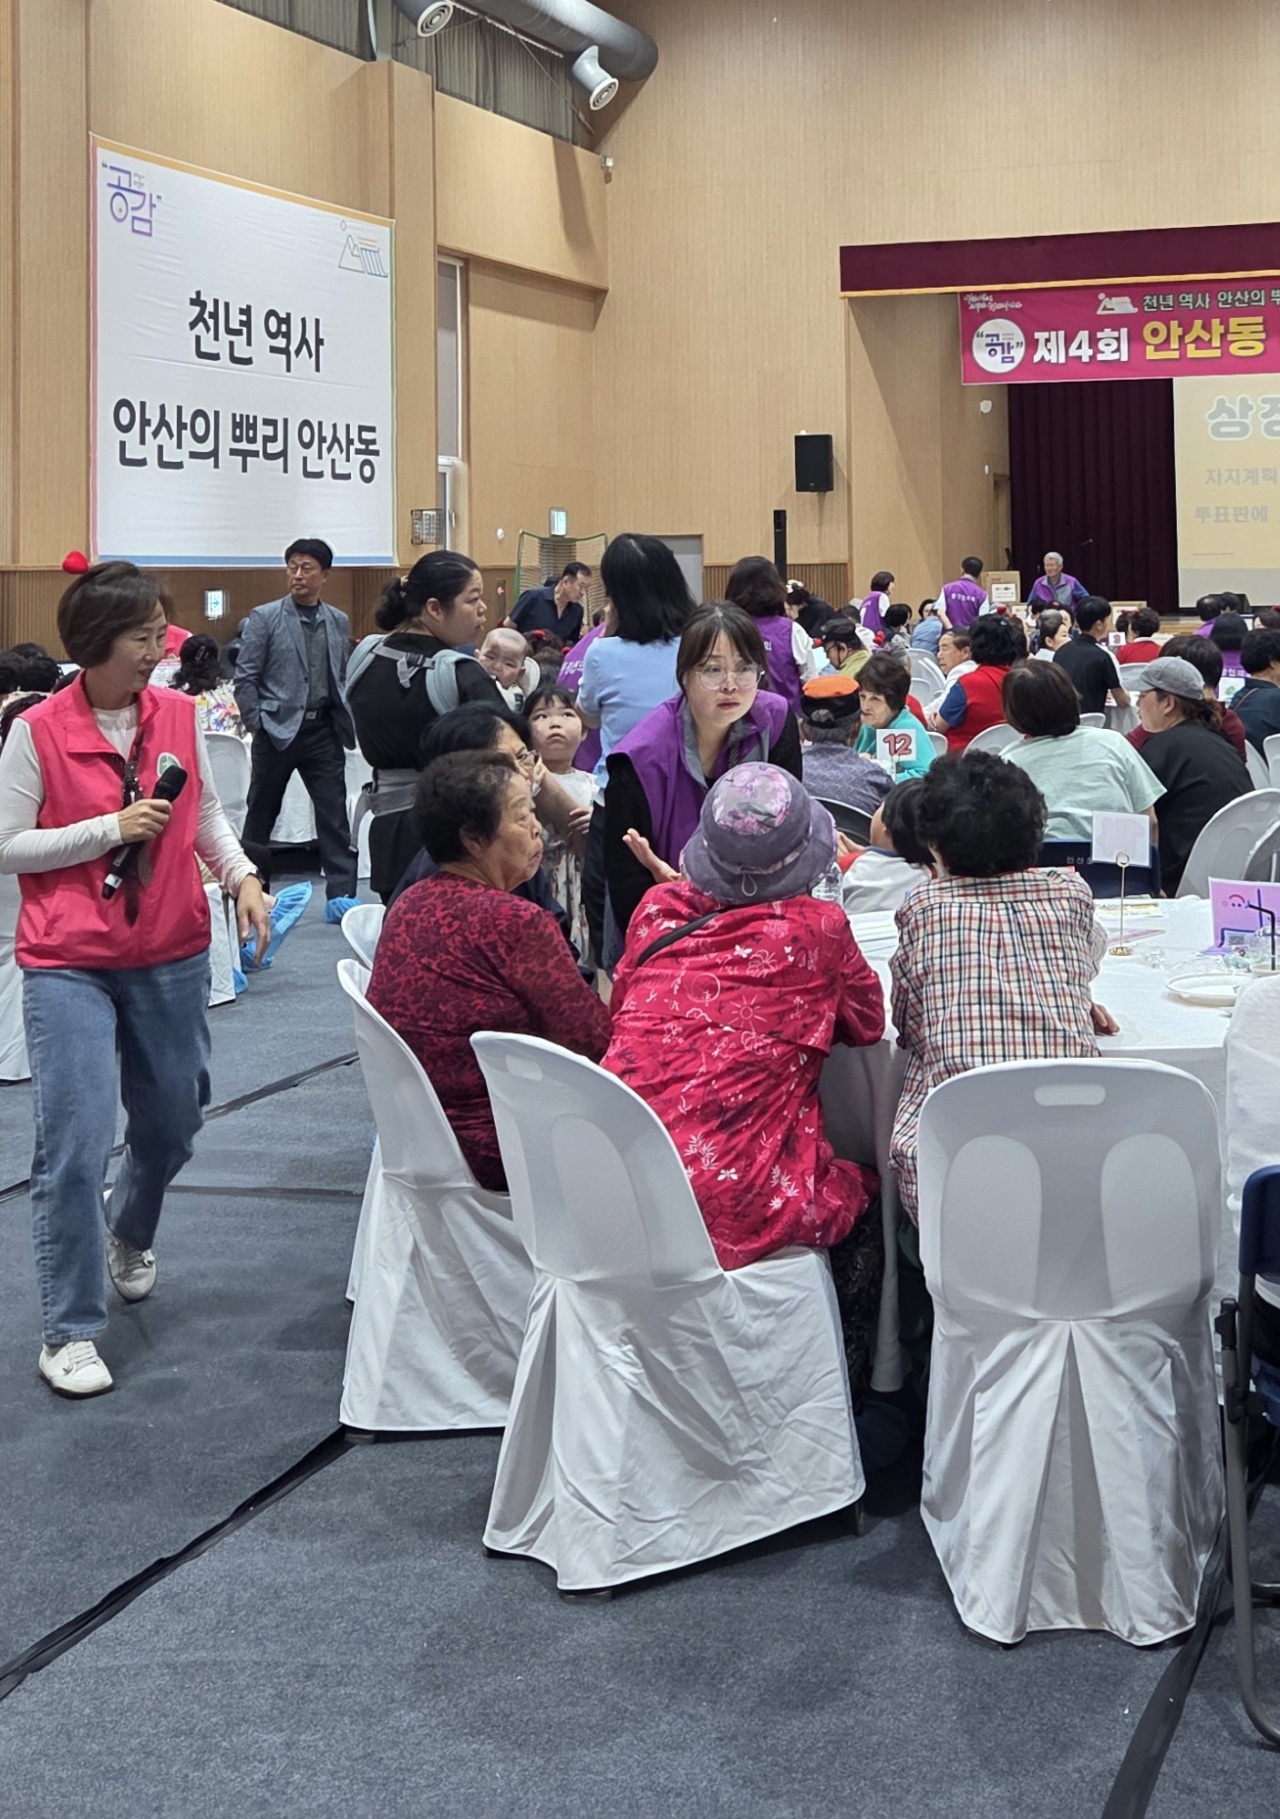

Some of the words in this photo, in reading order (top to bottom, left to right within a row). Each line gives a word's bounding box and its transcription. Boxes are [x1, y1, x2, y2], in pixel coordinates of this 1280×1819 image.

[1142, 295, 1174, 313] 천년
[1178, 293, 1211, 311] 역사
[1217, 289, 1266, 309] 안산의
[188, 288, 255, 367] 천년
[263, 308, 325, 374] 역사
[1033, 326, 1130, 364] 제4회
[1141, 316, 1267, 360] 안산동
[112, 397, 221, 470] 안산의
[229, 412, 290, 475] 뿌리
[299, 418, 381, 484] 안산동
[1193, 504, 1269, 525] 투표판에
[882, 733, 912, 756] 12
